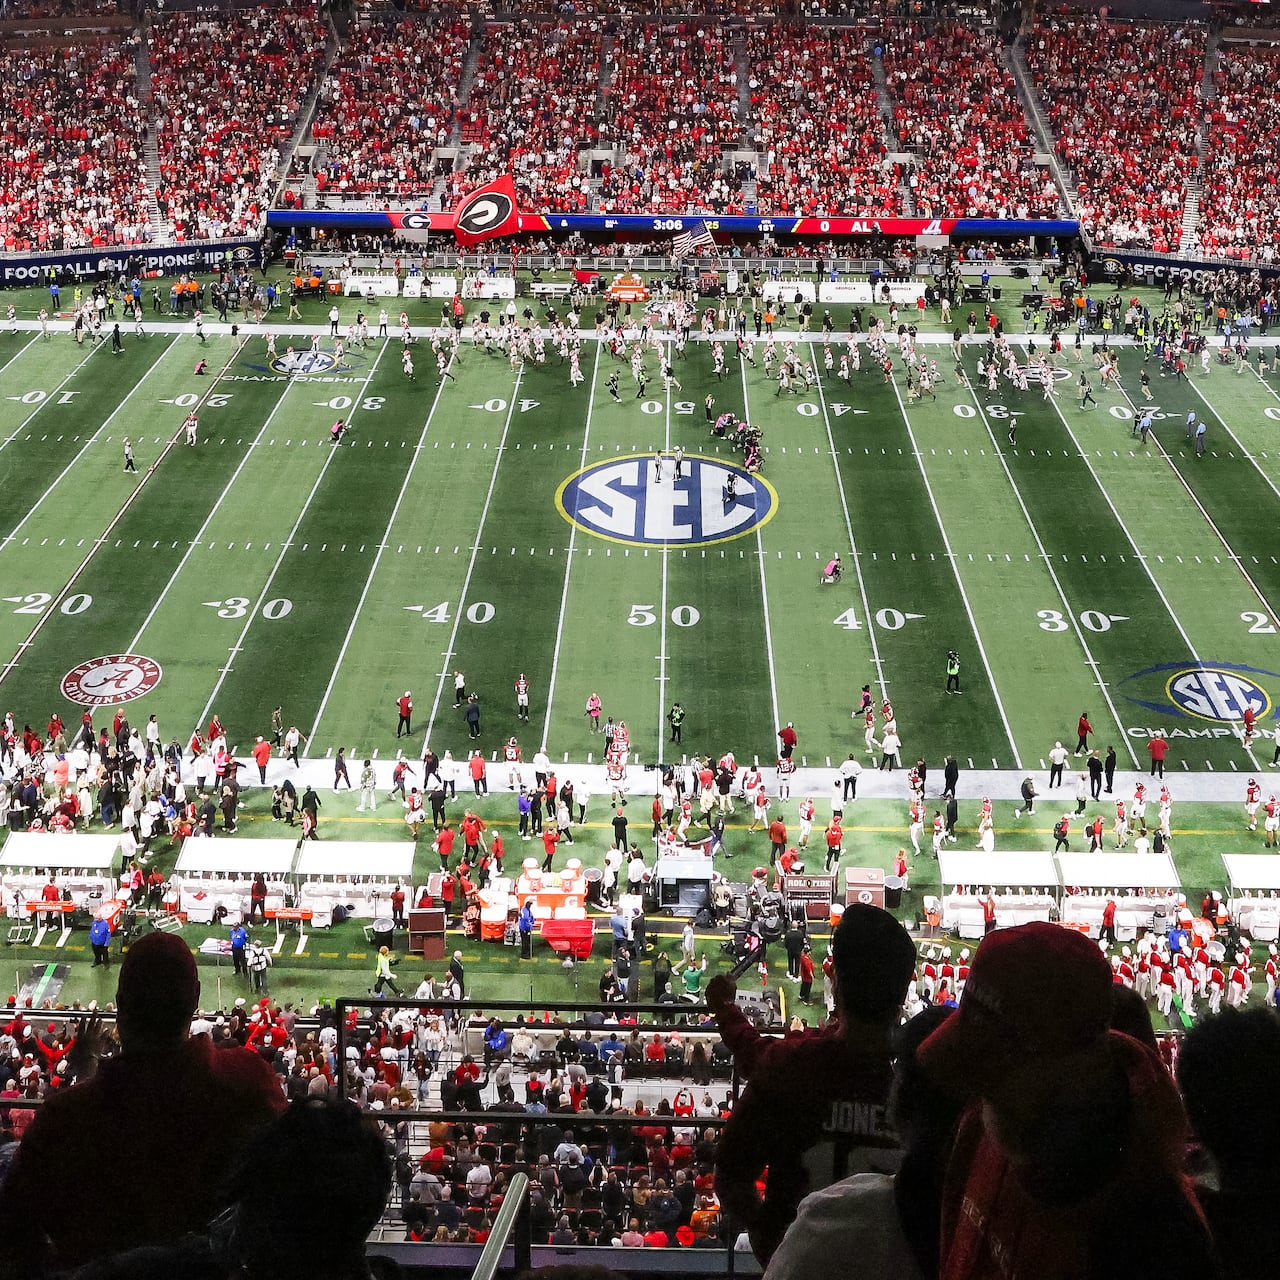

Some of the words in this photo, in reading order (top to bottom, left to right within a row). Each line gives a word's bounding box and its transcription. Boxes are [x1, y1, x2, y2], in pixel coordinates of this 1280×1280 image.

[653, 219, 683, 231] 3:06
[757, 223, 775, 232] 1ST
[820, 221, 830, 231] 0
[1133, 263, 1165, 278] SEC
[577, 459, 758, 539] SEC
[17, 590, 93, 617] 20
[219, 596, 293, 620] 30
[422, 600, 496, 625] 40
[626, 603, 701, 629] 50
[831, 604, 906, 631] 40
[1034, 608, 1111, 634] 30
[1176, 671, 1267, 720] SEC
[822, 1102, 883, 1134] JONES
